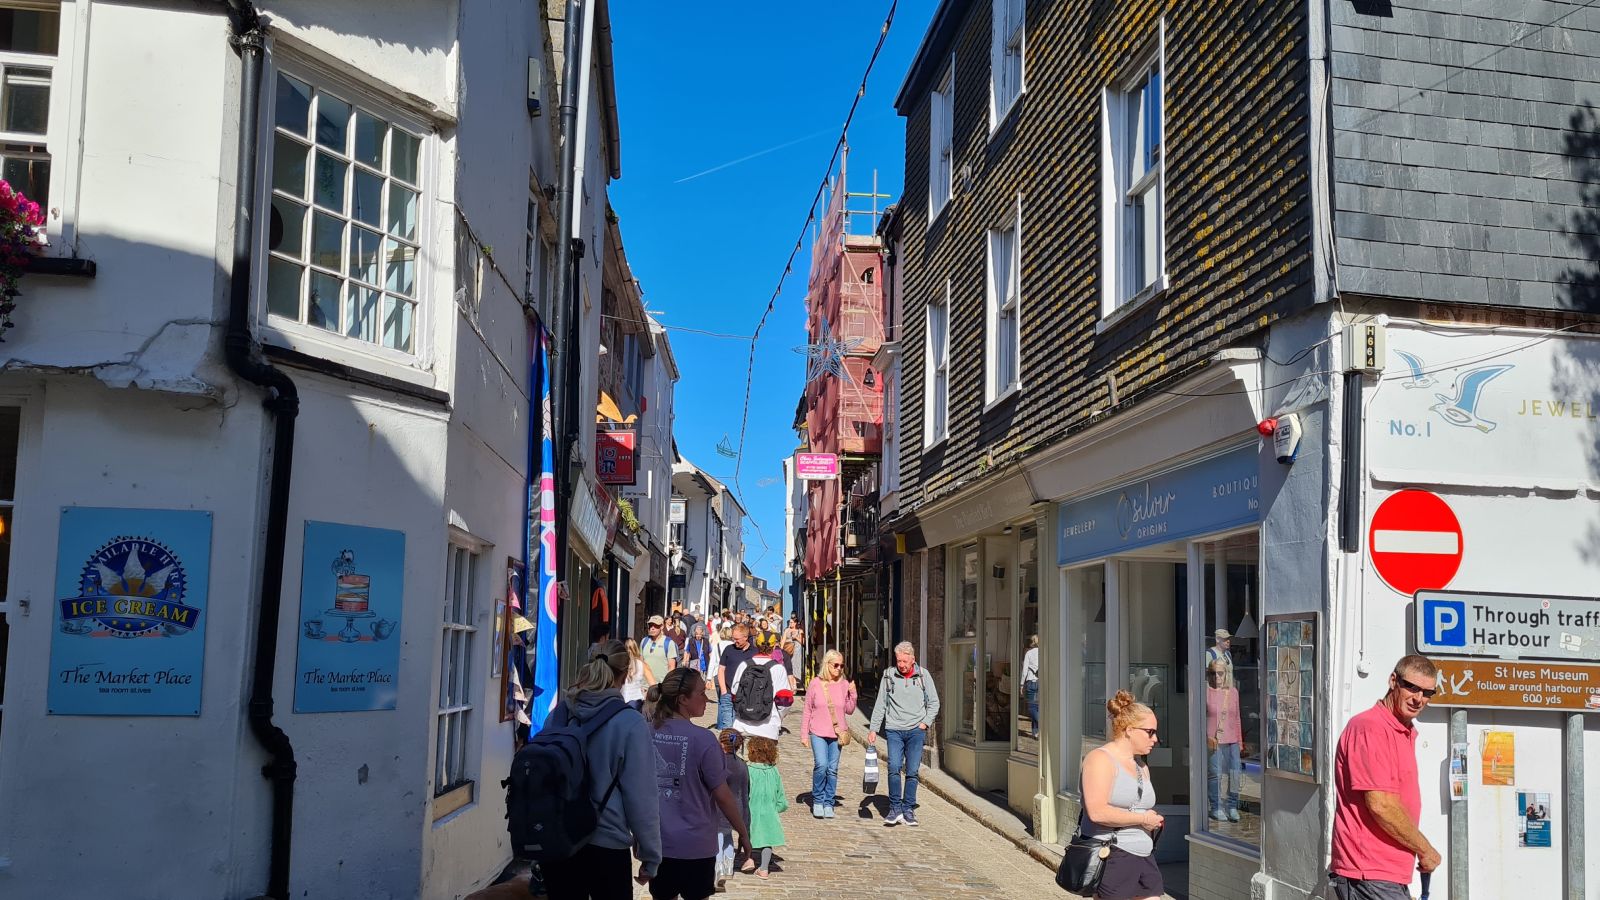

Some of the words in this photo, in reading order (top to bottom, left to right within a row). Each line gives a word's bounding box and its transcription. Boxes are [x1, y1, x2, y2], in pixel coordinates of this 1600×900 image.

[1518, 399, 1597, 419] JEWEL
[1063, 520, 1096, 538] JEWELLERY
[1137, 521, 1167, 539] ORIGINS
[71, 600, 107, 616] ICE
[114, 599, 189, 623] CREAM
[1473, 605, 1550, 628] Through
[1558, 610, 1600, 627] traff
[1434, 606, 1459, 642] P
[1473, 628, 1550, 647] Harbour
[60, 666, 91, 684] The
[94, 667, 150, 684] Market
[153, 667, 192, 685] Place
[303, 668, 325, 684] The
[327, 668, 365, 684] Market
[366, 668, 391, 683] Place
[1494, 667, 1508, 678] St
[1512, 667, 1536, 679] Ives
[1540, 668, 1589, 681] Museum
[1477, 681, 1506, 691] follow
[1509, 683, 1542, 692] around
[1545, 684, 1582, 694] harbour
[1522, 694, 1543, 703] 600
[1545, 695, 1562, 705] yds
